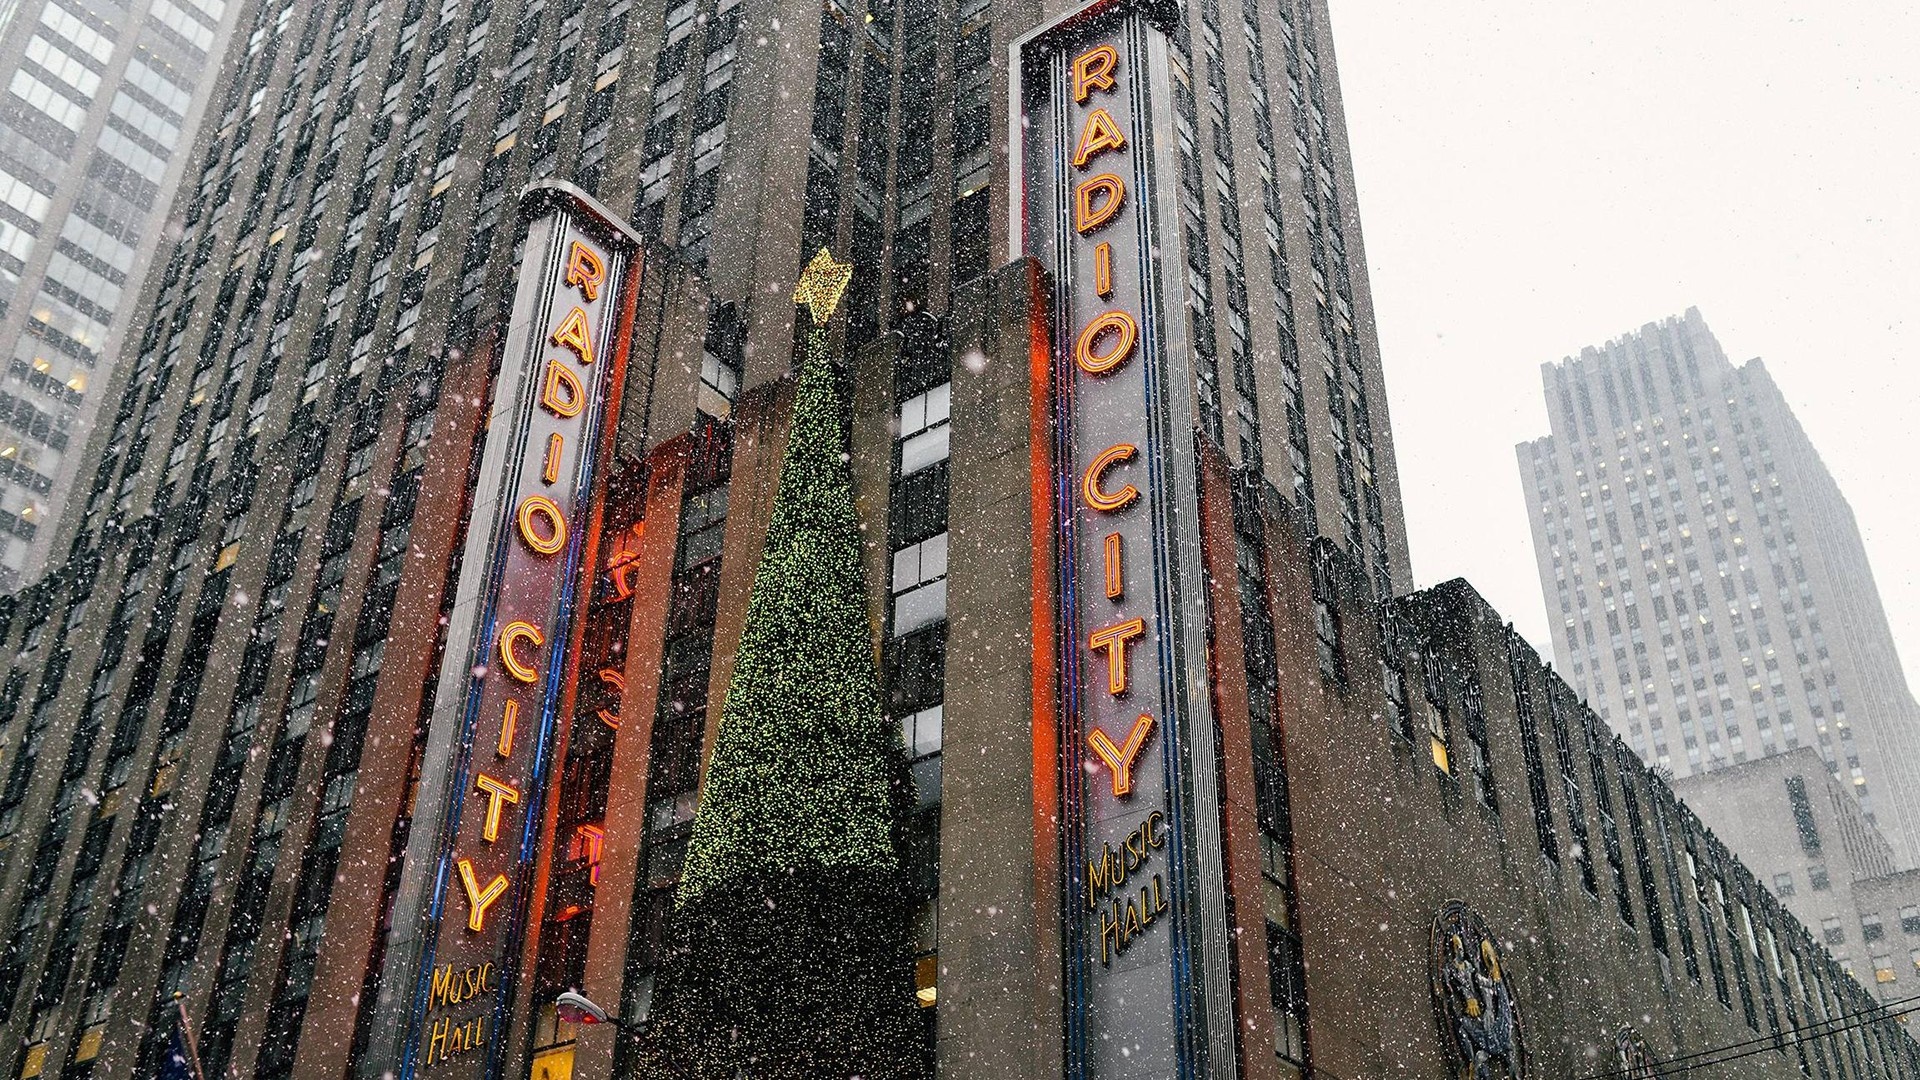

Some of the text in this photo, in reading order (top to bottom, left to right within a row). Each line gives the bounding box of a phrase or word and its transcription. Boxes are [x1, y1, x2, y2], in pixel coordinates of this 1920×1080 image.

[457, 240, 605, 931] RADIO CITY
[1073, 45, 1156, 796] RADIO CITY
